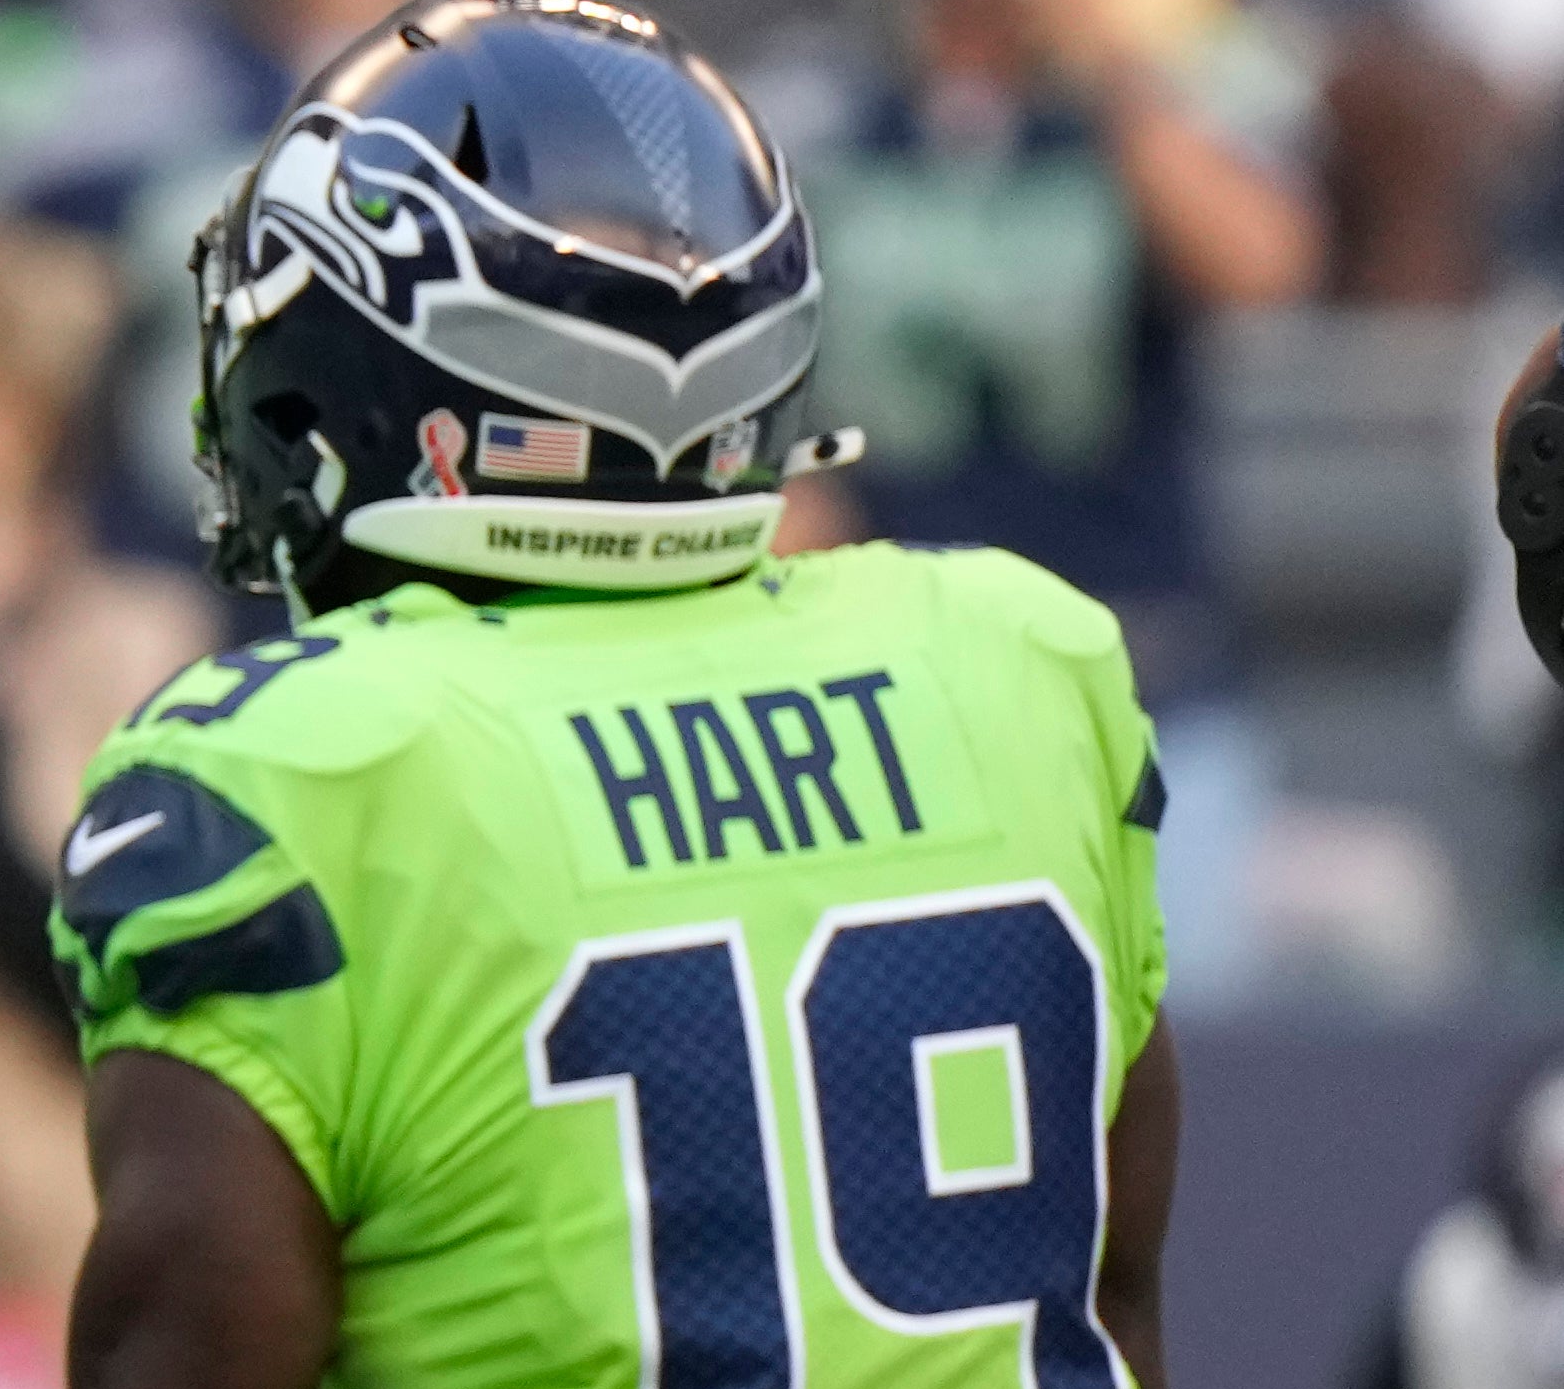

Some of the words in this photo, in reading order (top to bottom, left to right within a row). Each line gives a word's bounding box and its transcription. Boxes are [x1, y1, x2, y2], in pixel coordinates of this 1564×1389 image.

[487, 521, 642, 558] INSPIRE
[651, 518, 764, 560] CHAN
[568, 668, 924, 871] HART
